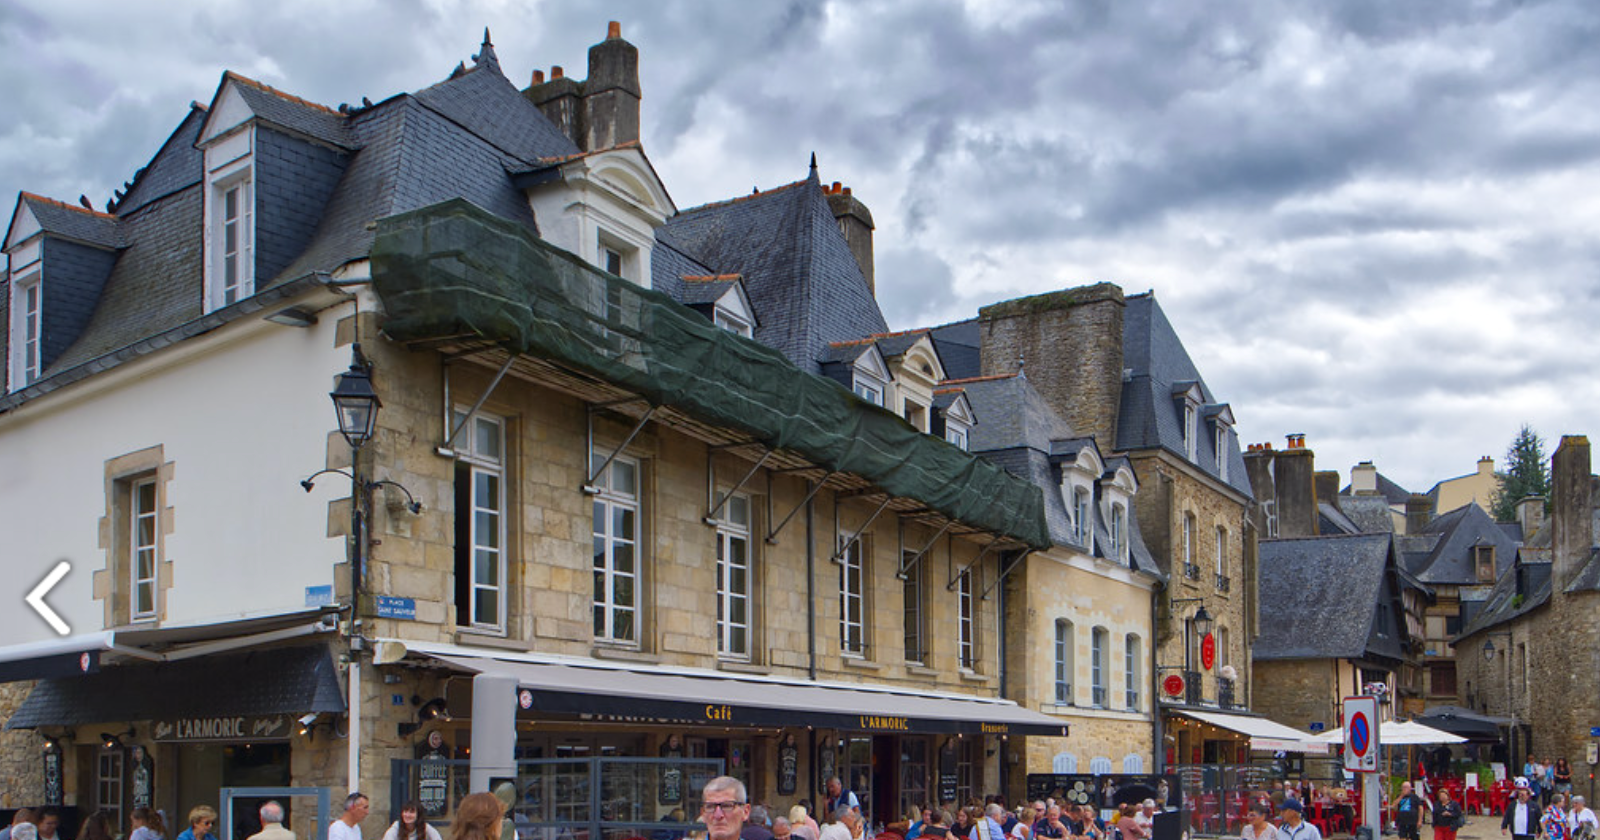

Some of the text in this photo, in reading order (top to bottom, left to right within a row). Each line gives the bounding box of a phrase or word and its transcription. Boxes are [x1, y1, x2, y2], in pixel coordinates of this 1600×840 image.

[706, 704, 732, 720] Café
[176, 717, 245, 738] L'ARMORIC
[860, 715, 909, 730] L'ARMORIC
[981, 722, 1009, 733] Brasserie
